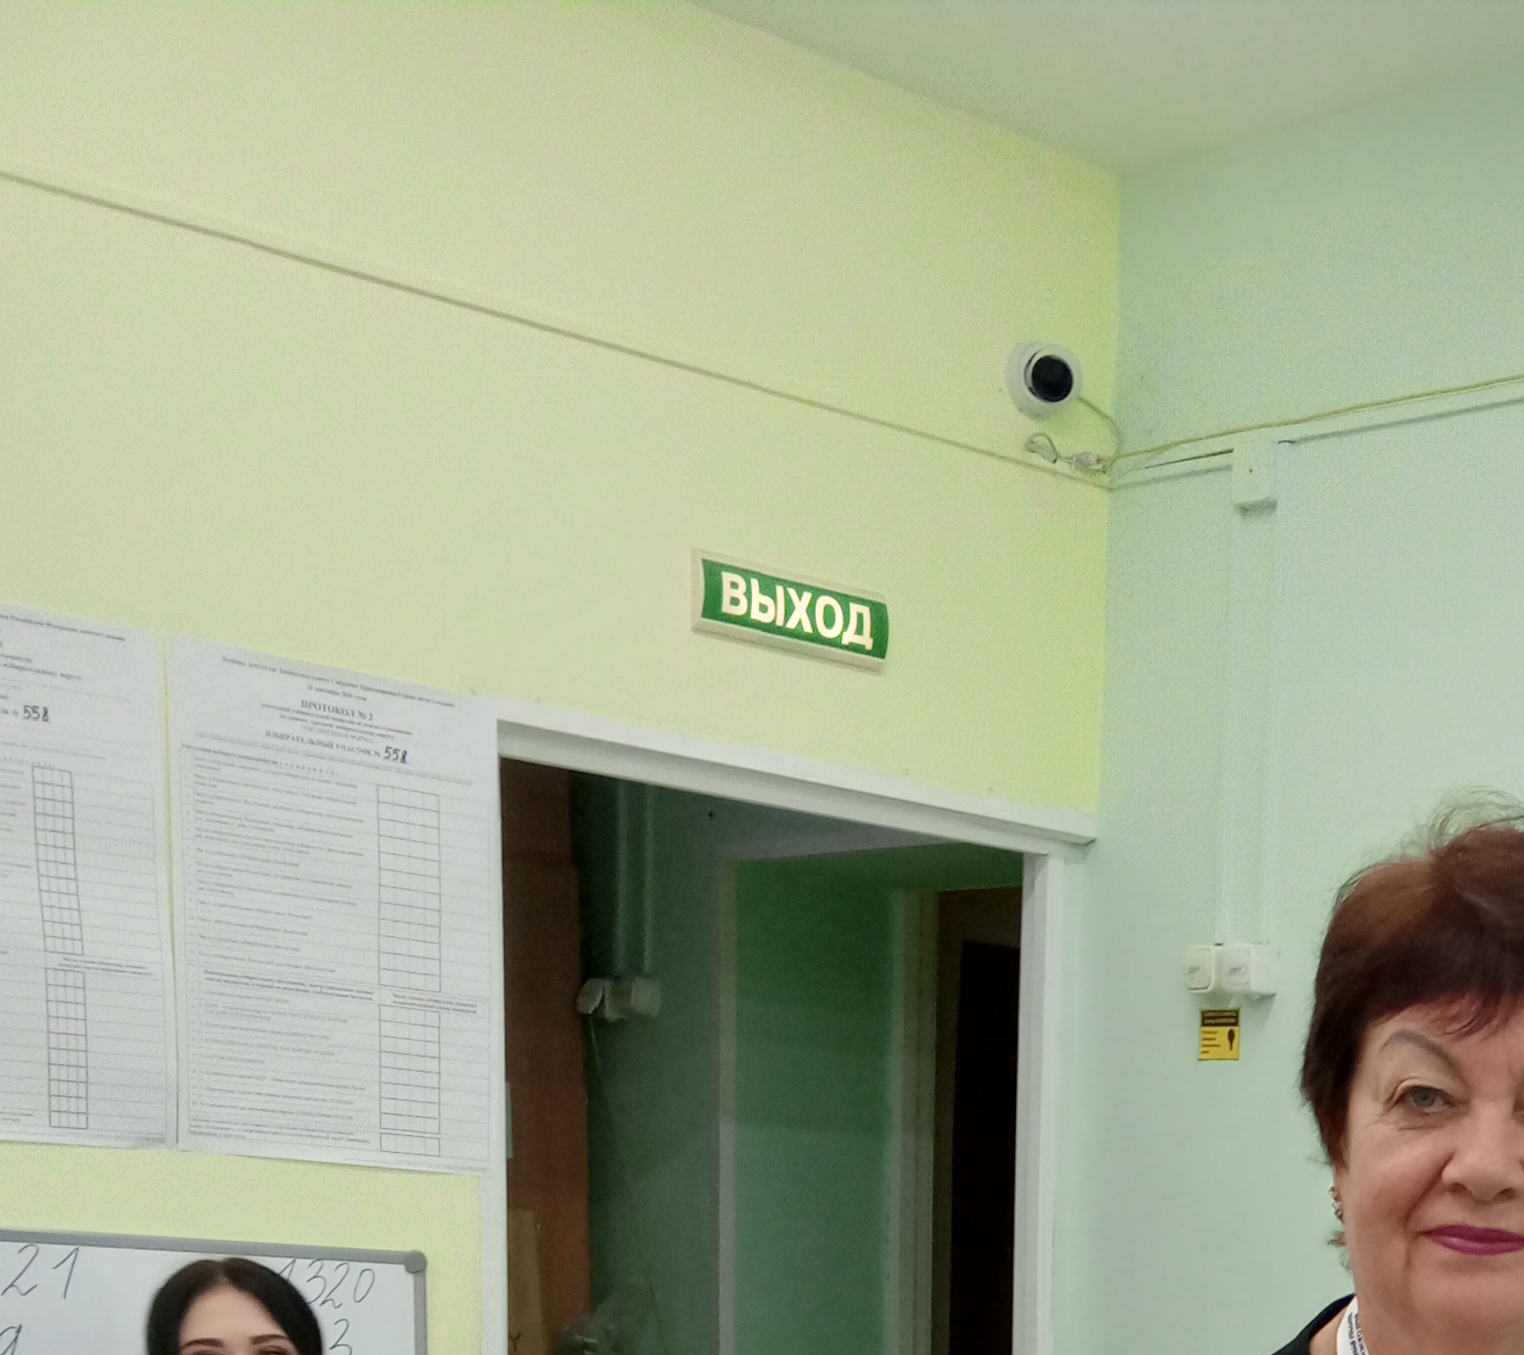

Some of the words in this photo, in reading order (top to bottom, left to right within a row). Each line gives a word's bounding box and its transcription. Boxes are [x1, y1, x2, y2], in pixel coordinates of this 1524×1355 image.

[721, 571, 873, 650] ВЫХОД
[23, 705, 50, 722] 558
[384, 746, 409, 764] 558
